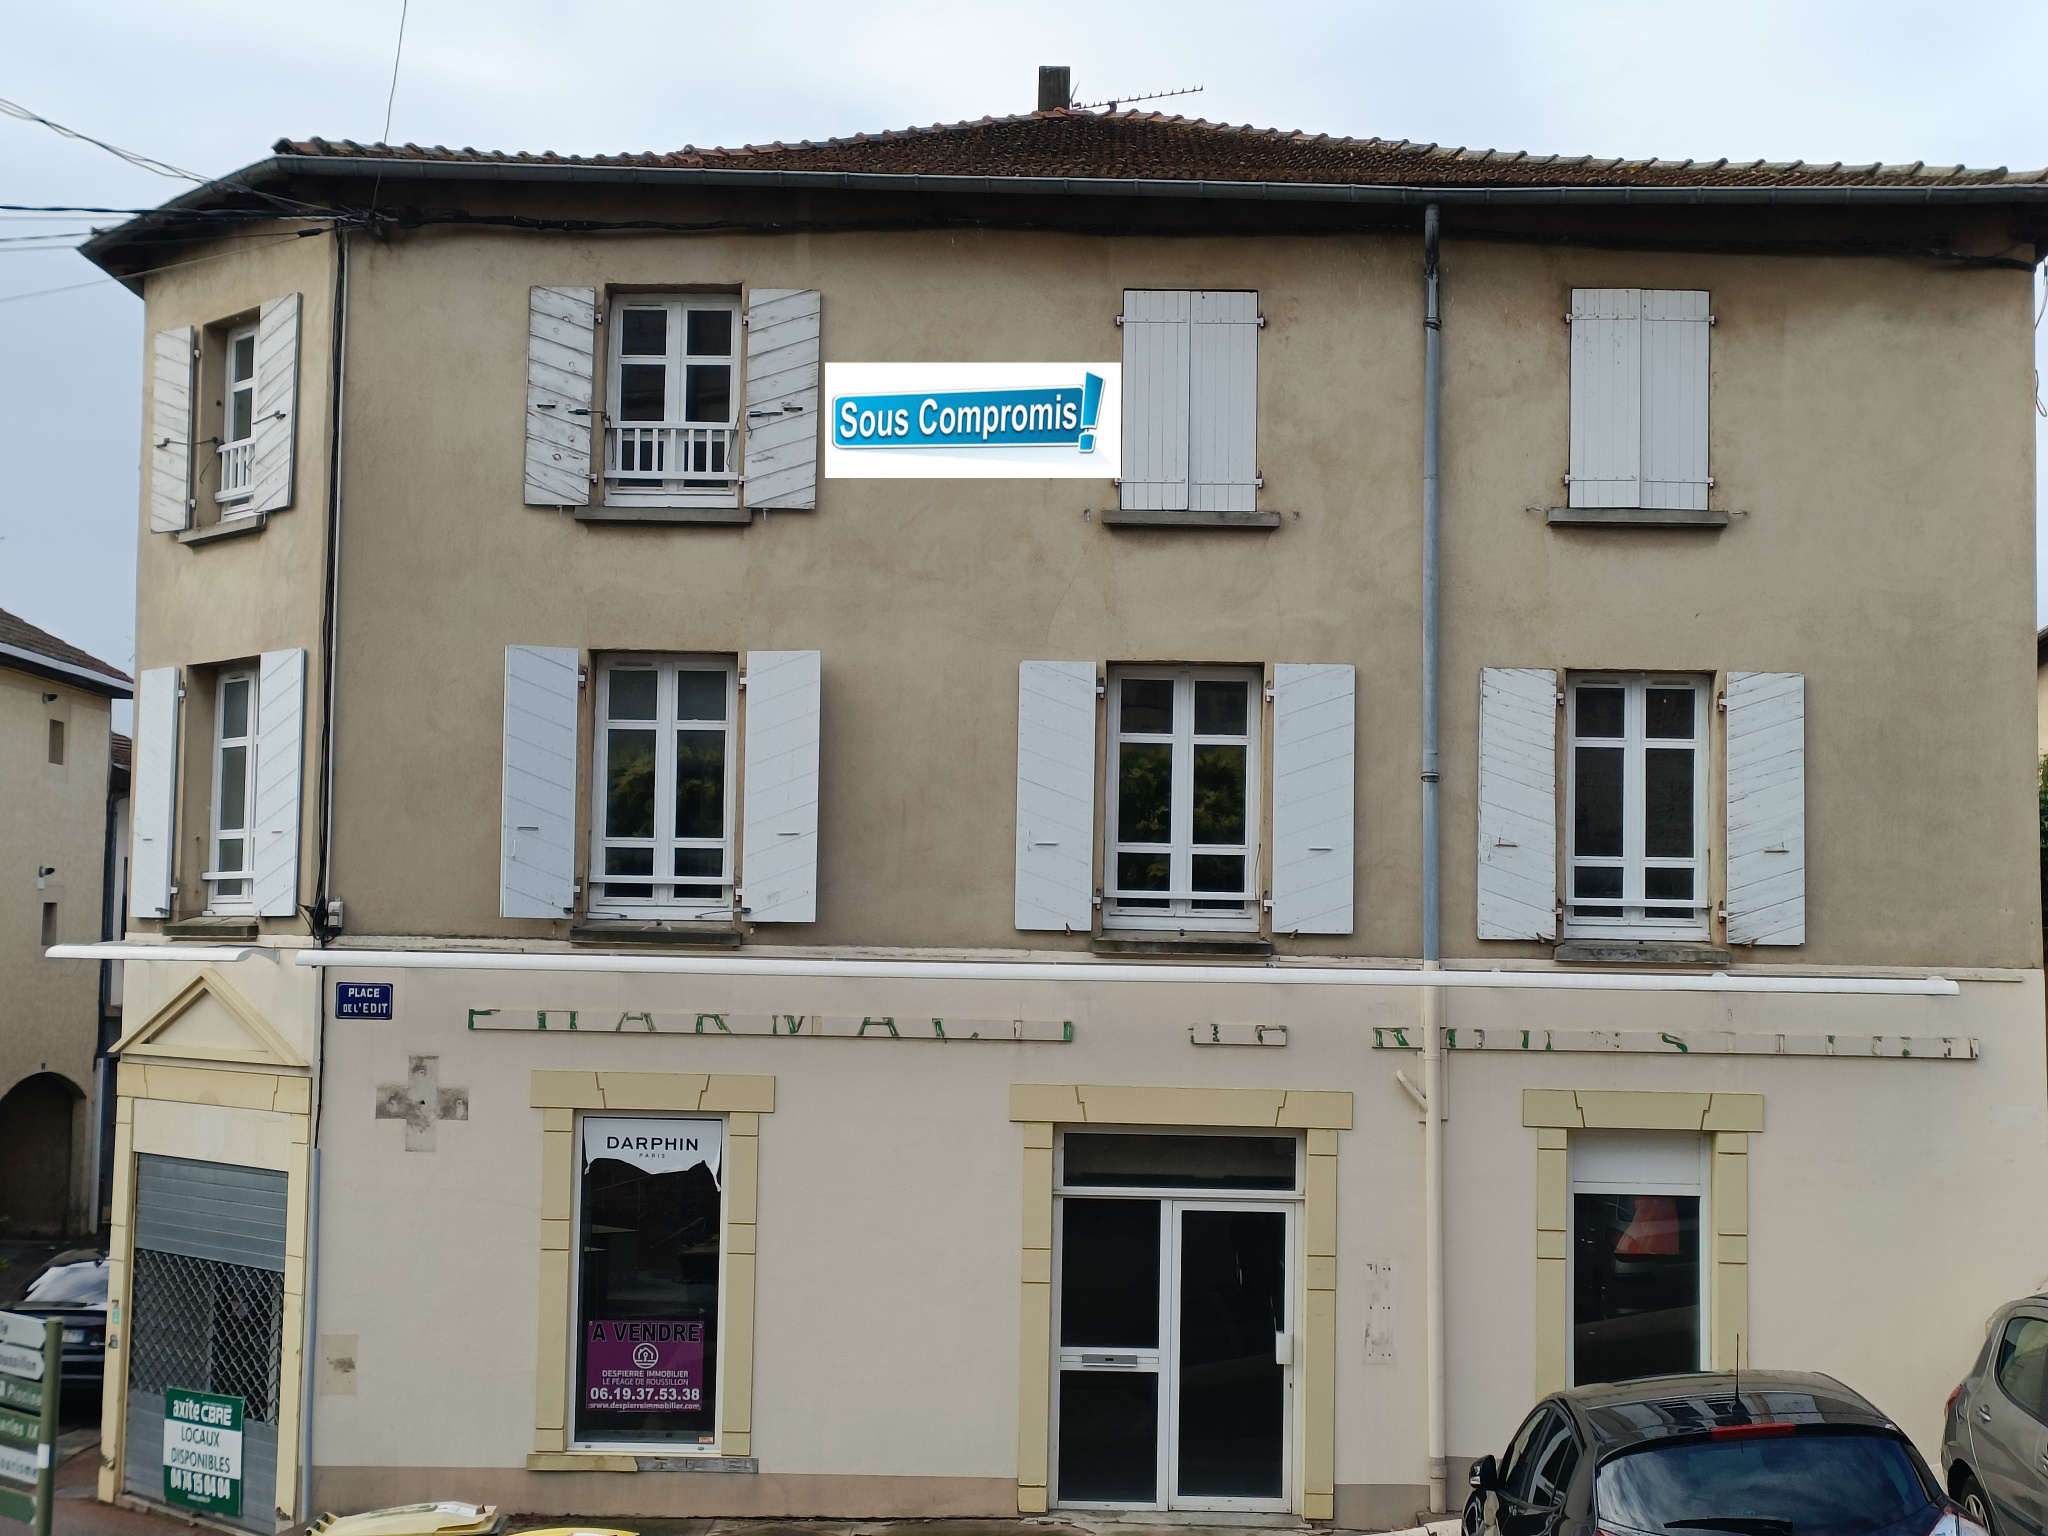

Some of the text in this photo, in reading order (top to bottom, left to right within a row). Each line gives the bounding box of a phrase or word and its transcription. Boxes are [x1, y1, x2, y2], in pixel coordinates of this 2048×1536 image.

[348, 988, 380, 998] PLACE
[606, 1136, 699, 1151] DARPHIN
[591, 1322, 702, 1343] A VENDRE
[602, 1370, 689, 1378] DESPIERRE IMMOBILIER
[602, 1378, 611, 1386] LE
[635, 1378, 645, 1386] DE
[646, 1378, 689, 1386] ROUSSILLON
[590, 1387, 700, 1401] 06.19.37.53.38
[173, 1398, 232, 1427] axite CBRE
[181, 1426, 220, 1447] LOCAUX
[171, 1447, 230, 1474] DISPONIBLES
